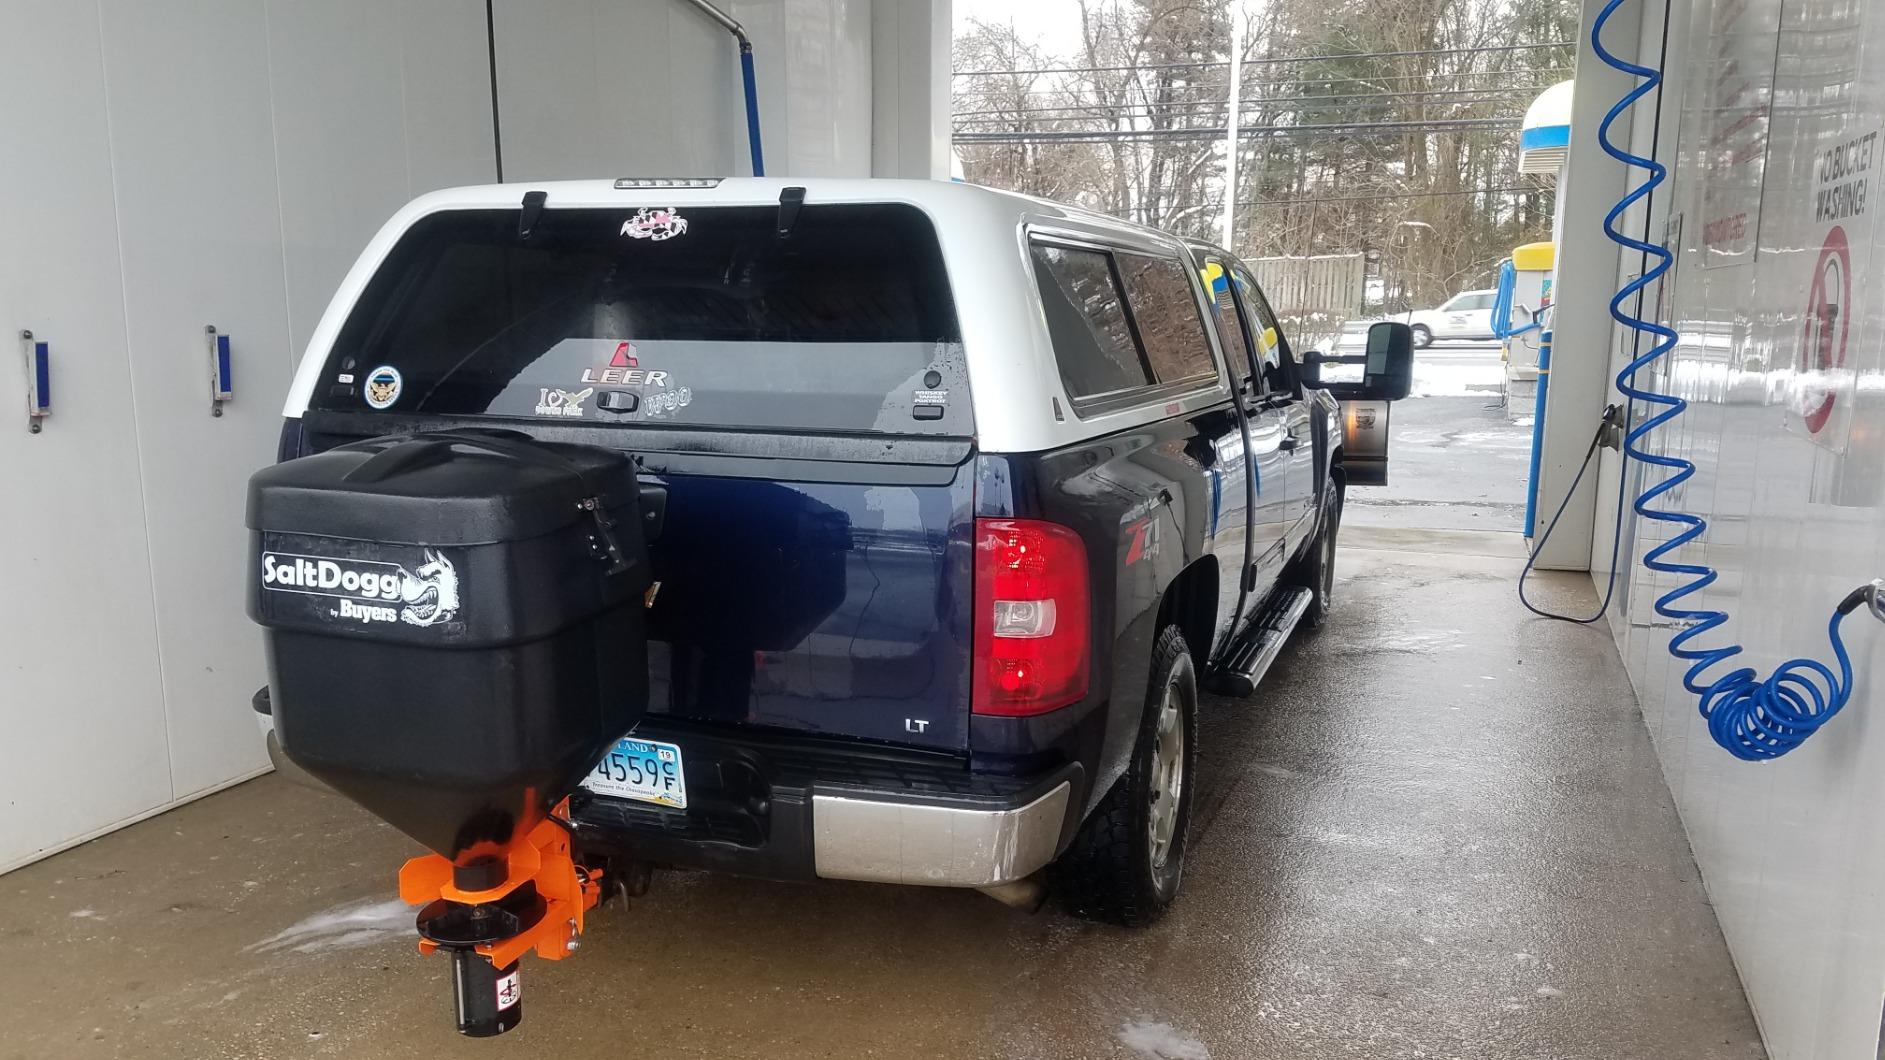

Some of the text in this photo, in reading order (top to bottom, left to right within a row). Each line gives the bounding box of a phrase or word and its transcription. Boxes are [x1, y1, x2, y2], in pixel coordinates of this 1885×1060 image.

[1832, 131, 1877, 181] BUCKET
[1815, 177, 1868, 223] WASHING!
[580, 368, 668, 387] LEER
[264, 555, 402, 600] SaltDogg
[330, 599, 397, 623] by Buyers
[905, 718, 930, 733] LT
[660, 751, 672, 759] 19
